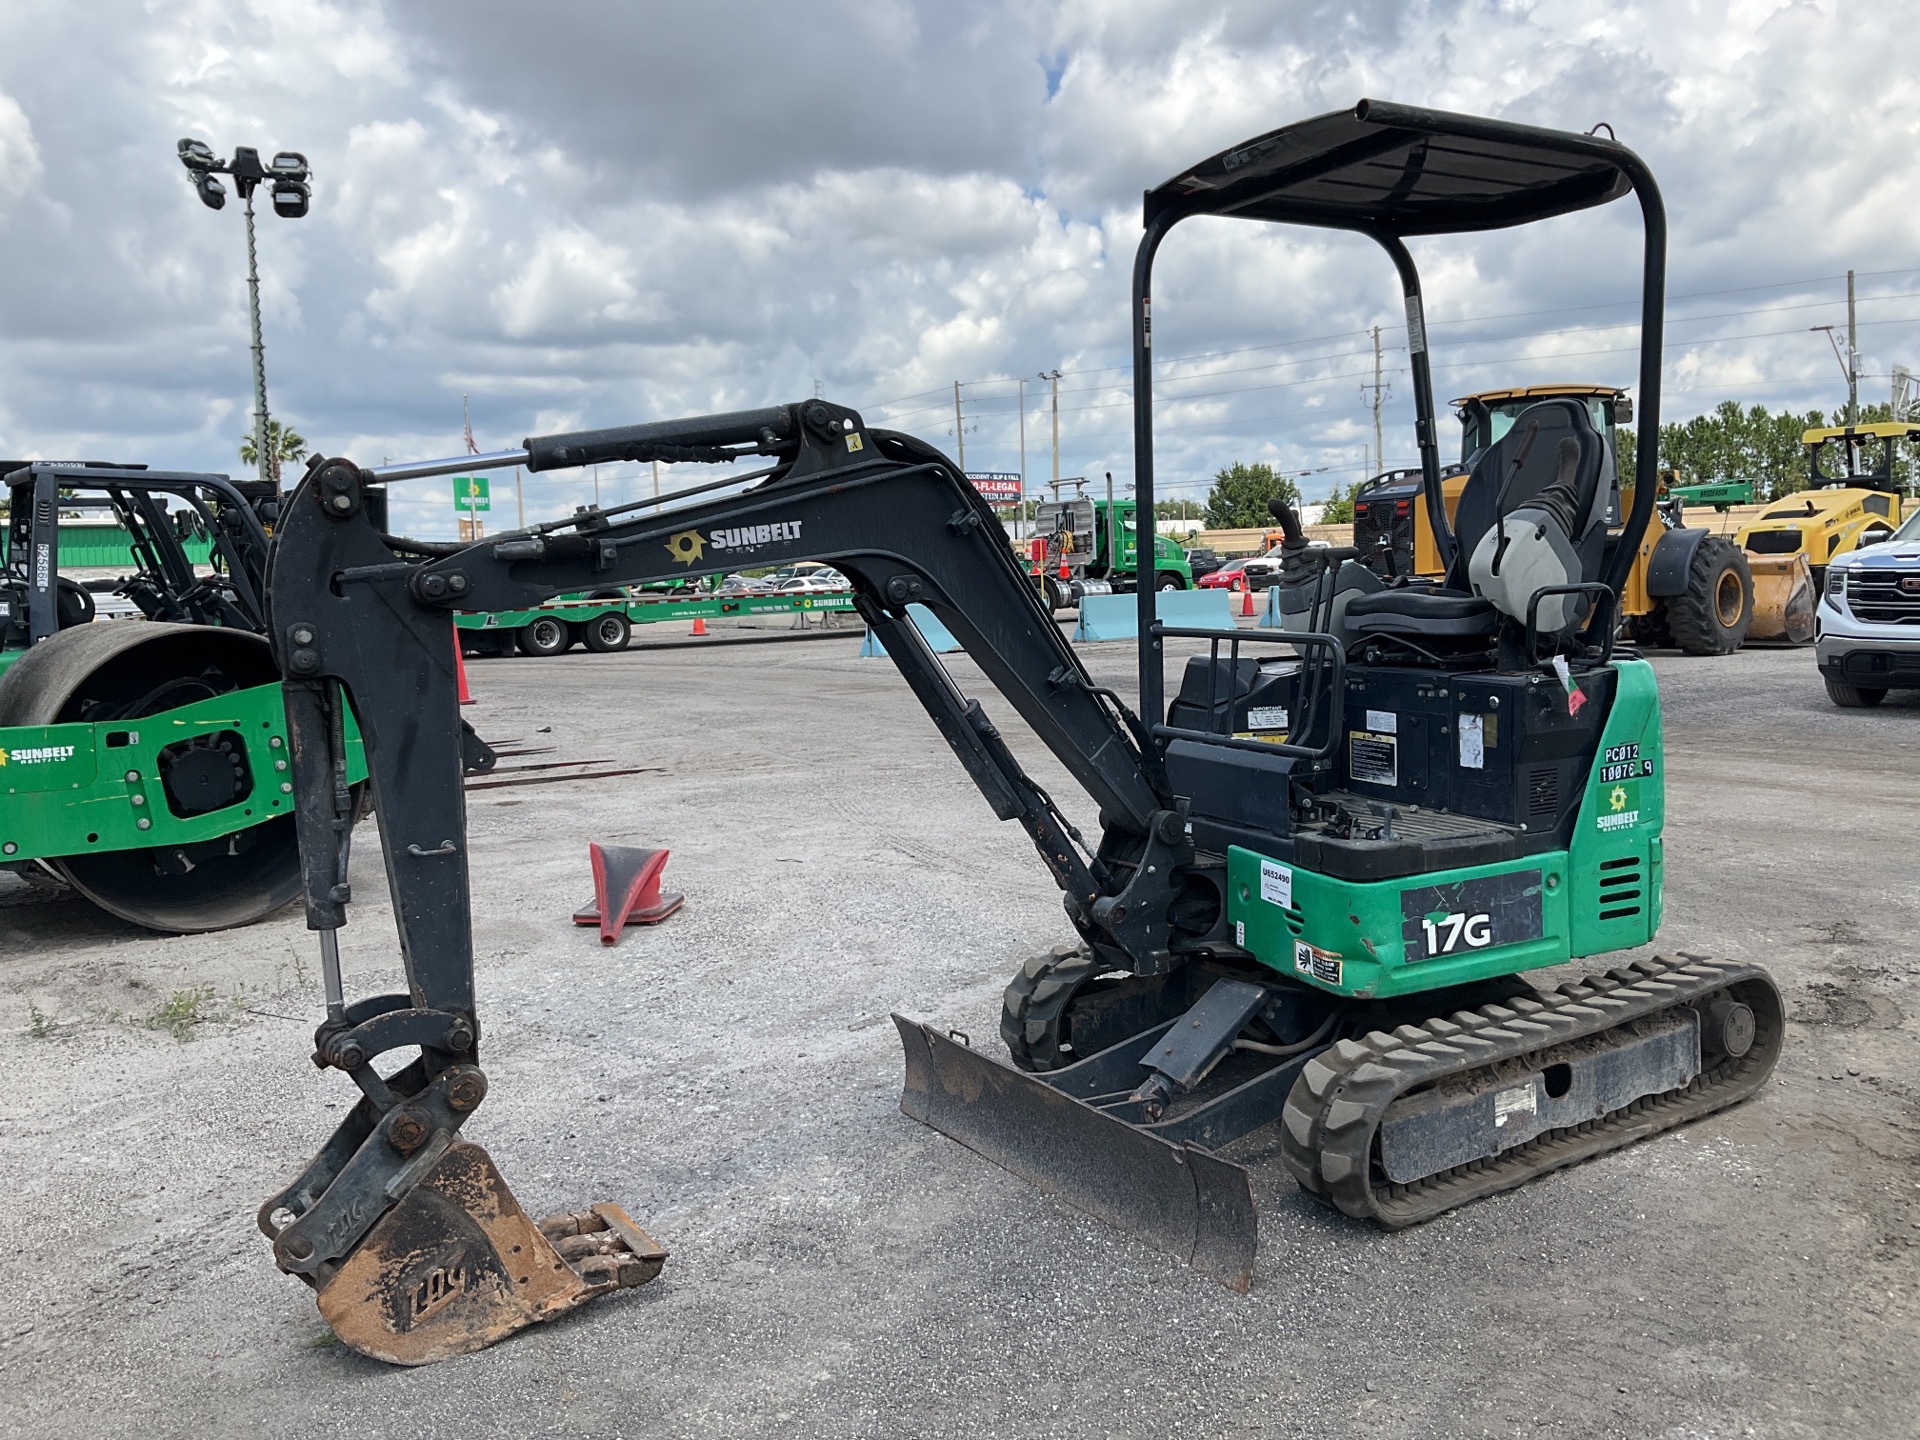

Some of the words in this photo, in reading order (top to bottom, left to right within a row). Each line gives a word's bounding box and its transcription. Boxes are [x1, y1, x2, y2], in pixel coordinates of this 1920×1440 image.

[972, 482, 1017, 491] 0-FL-LEGAL
[709, 520, 802, 549] SUNBELT
[813, 598, 844, 607] SUNBELT
[11, 745, 75, 761] SUNBELT
[1596, 810, 1639, 829] SUNBELT
[1602, 822, 1634, 832] RENTALS
[1263, 867, 1290, 884] U652490
[1422, 912, 1491, 955] 17G
